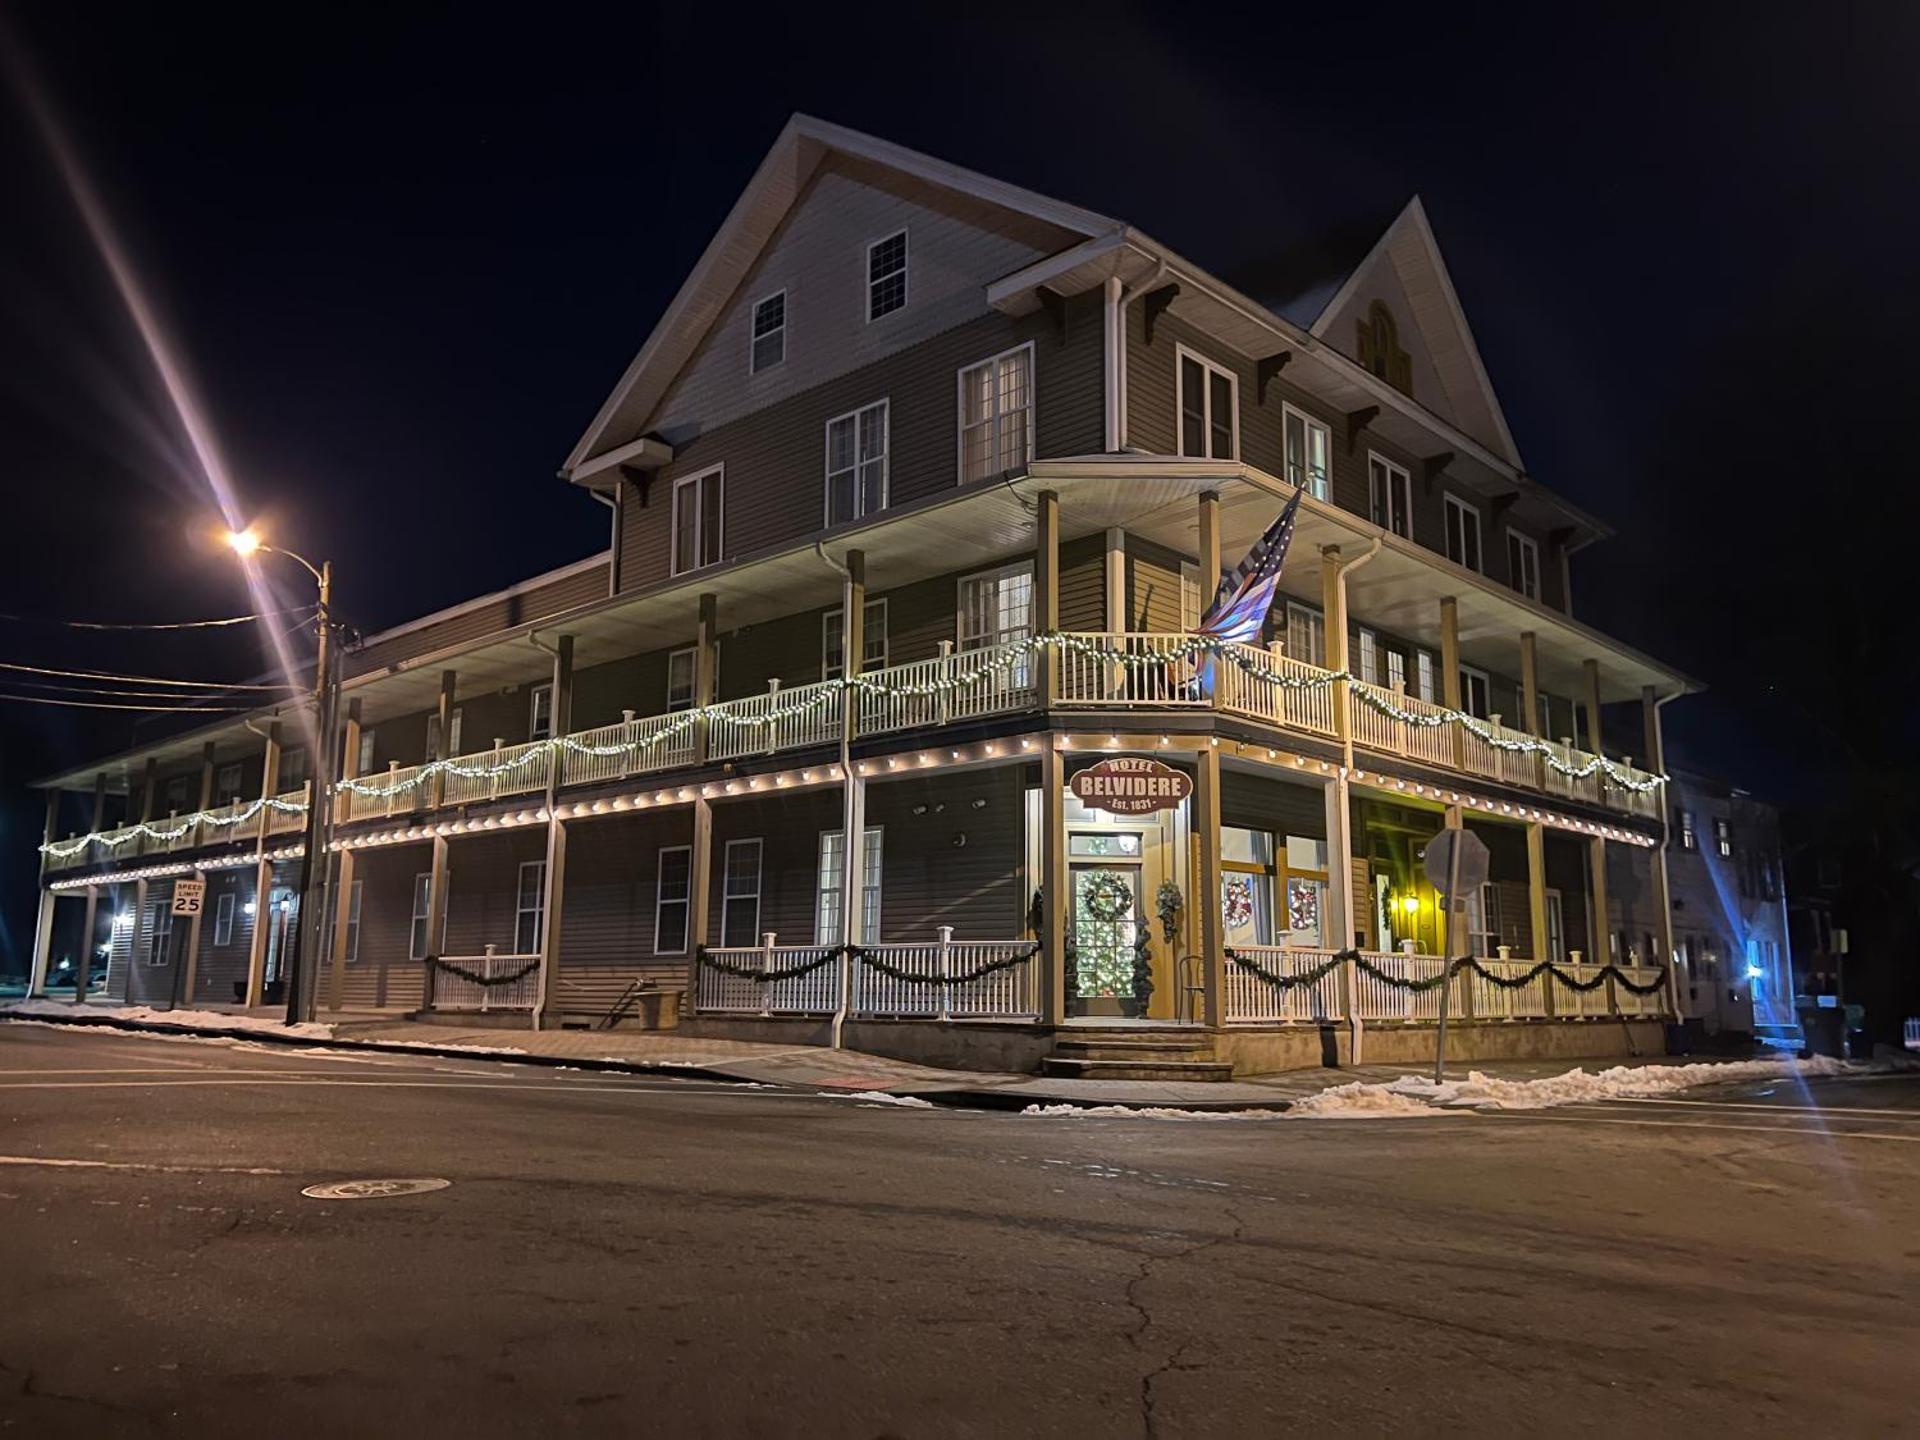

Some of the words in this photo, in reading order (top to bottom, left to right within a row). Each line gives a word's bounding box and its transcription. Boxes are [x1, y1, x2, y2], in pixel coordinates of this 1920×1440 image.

[1109, 760, 1153, 773] HOTEL
[1080, 776, 1181, 796] BELVIDERE
[1131, 799, 1152, 810] 1831
[175, 898, 200, 911] 25
